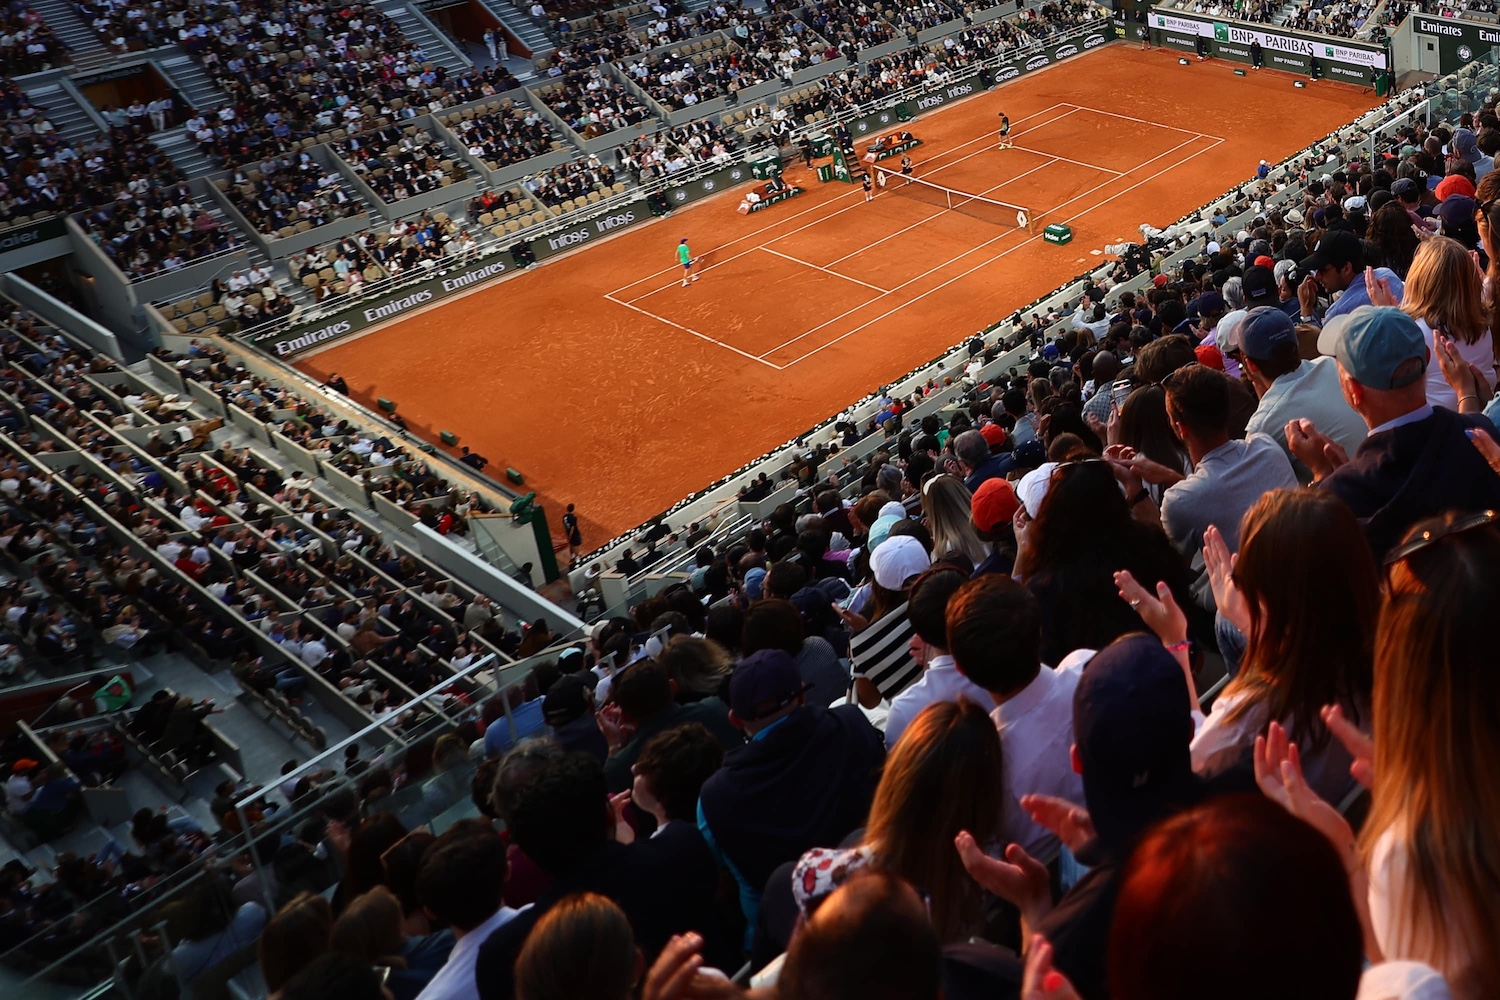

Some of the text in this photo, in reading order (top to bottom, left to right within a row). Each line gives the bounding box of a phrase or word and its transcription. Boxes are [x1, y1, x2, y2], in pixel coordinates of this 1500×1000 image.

[1178, 21, 1200, 30] PARIBAS
[1420, 20, 1463, 37] Emirates
[1231, 29, 1314, 55] BNP PARIBAS
[1349, 51, 1374, 61] PARIBAS
[946, 82, 973, 99] Infosys
[917, 93, 944, 110] Infosys
[595, 210, 635, 233] Infosys
[0, 230, 39, 248] aier
[547, 227, 590, 250] Infosys
[441, 261, 506, 292] Emirates
[362, 289, 433, 322] Emirates
[274, 320, 351, 355] Emirates
